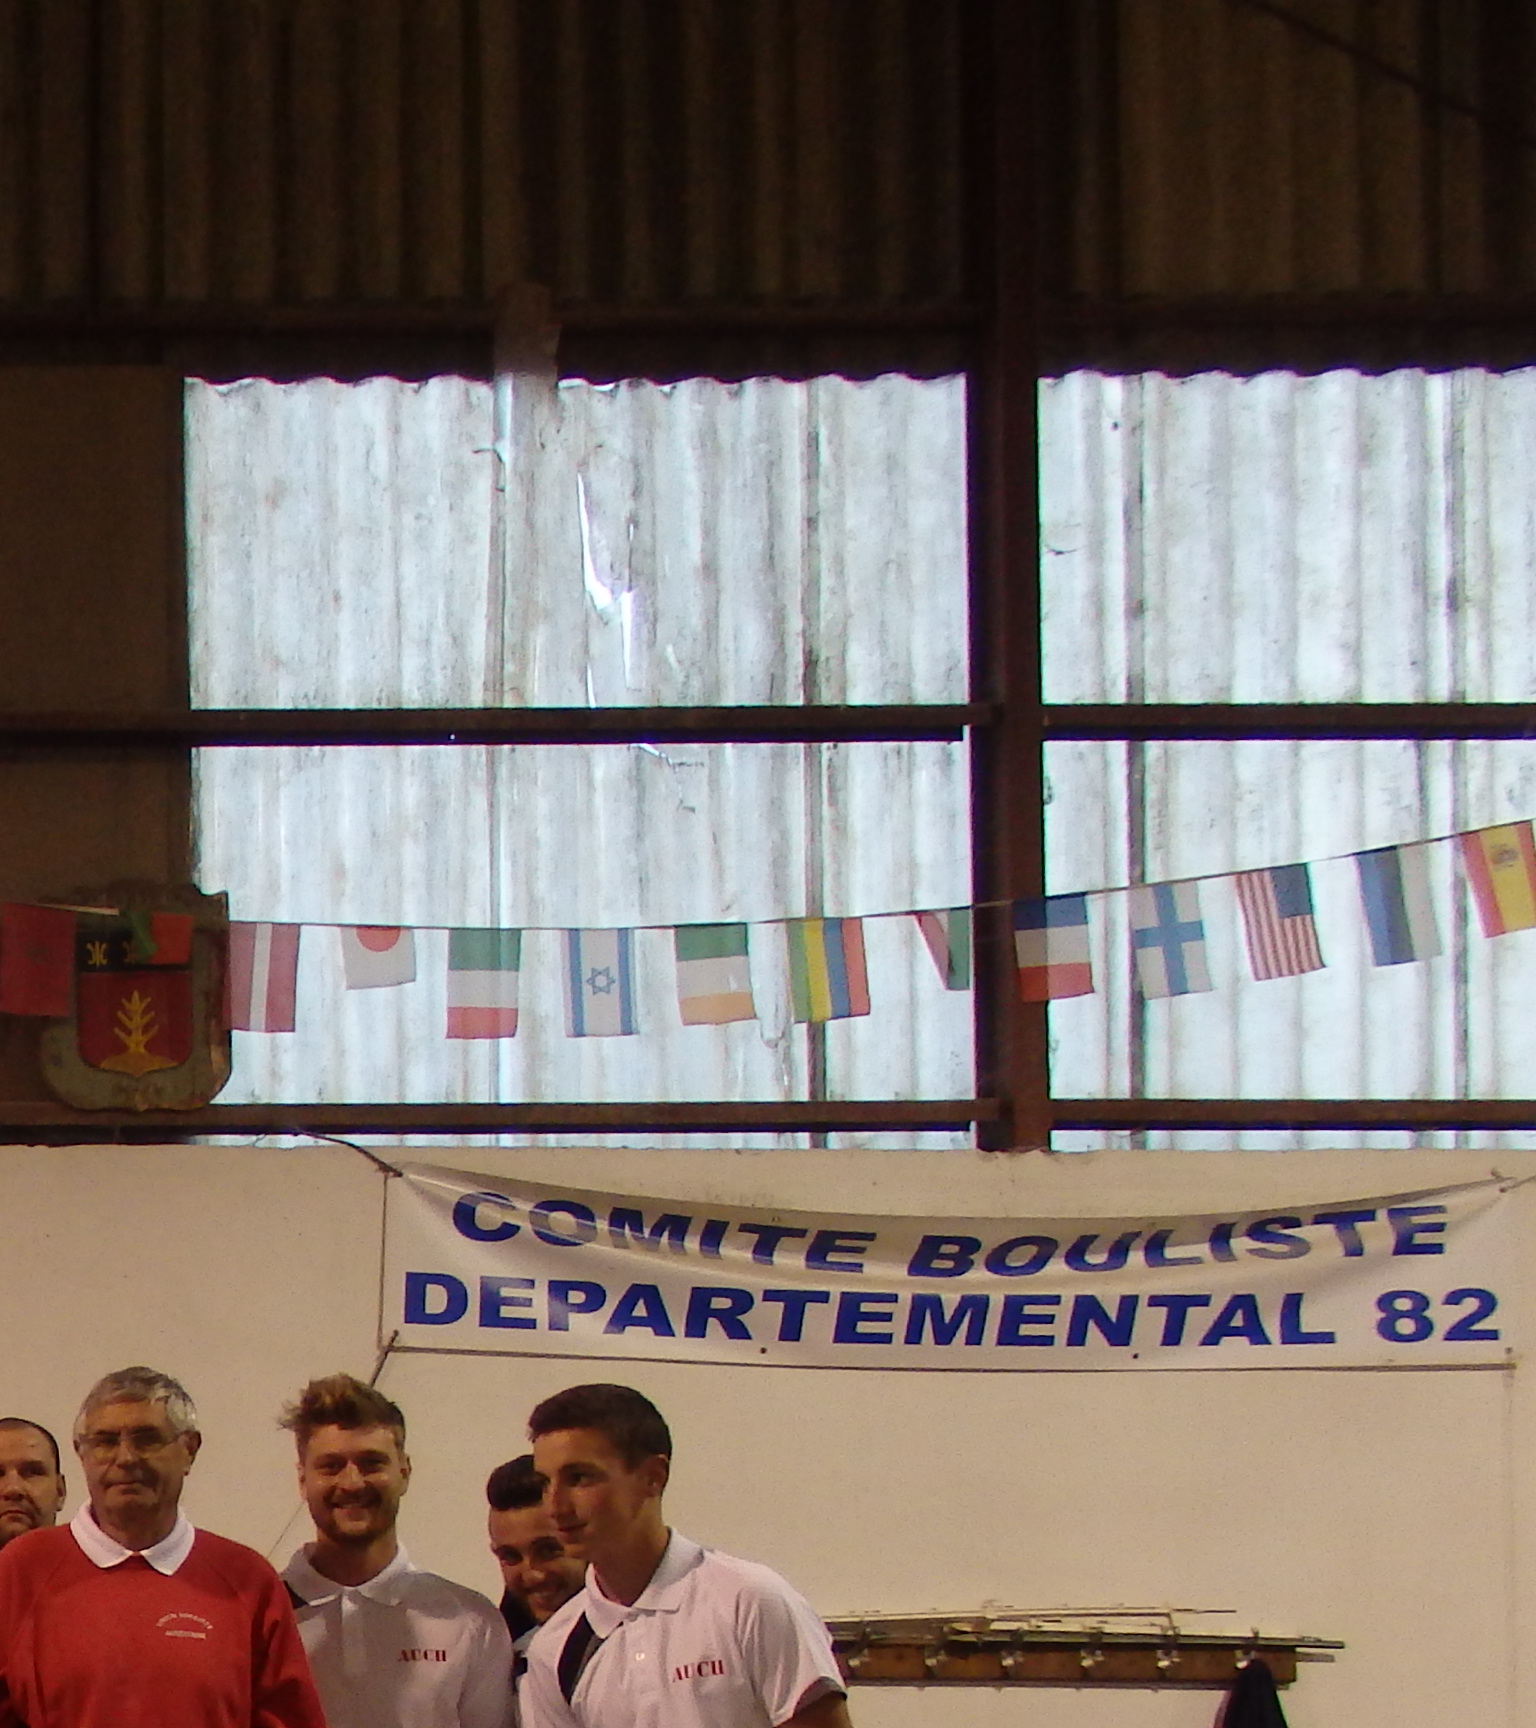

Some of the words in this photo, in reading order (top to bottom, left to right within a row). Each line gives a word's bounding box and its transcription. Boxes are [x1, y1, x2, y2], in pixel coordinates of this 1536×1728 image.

[452, 1191, 877, 1274] COMITE
[906, 1204, 1448, 1278] BOULISTE
[403, 1271, 1337, 1347] DEPARTEMENTAL
[1375, 1287, 1501, 1343] 82
[672, 1659, 725, 1683] AUCH
